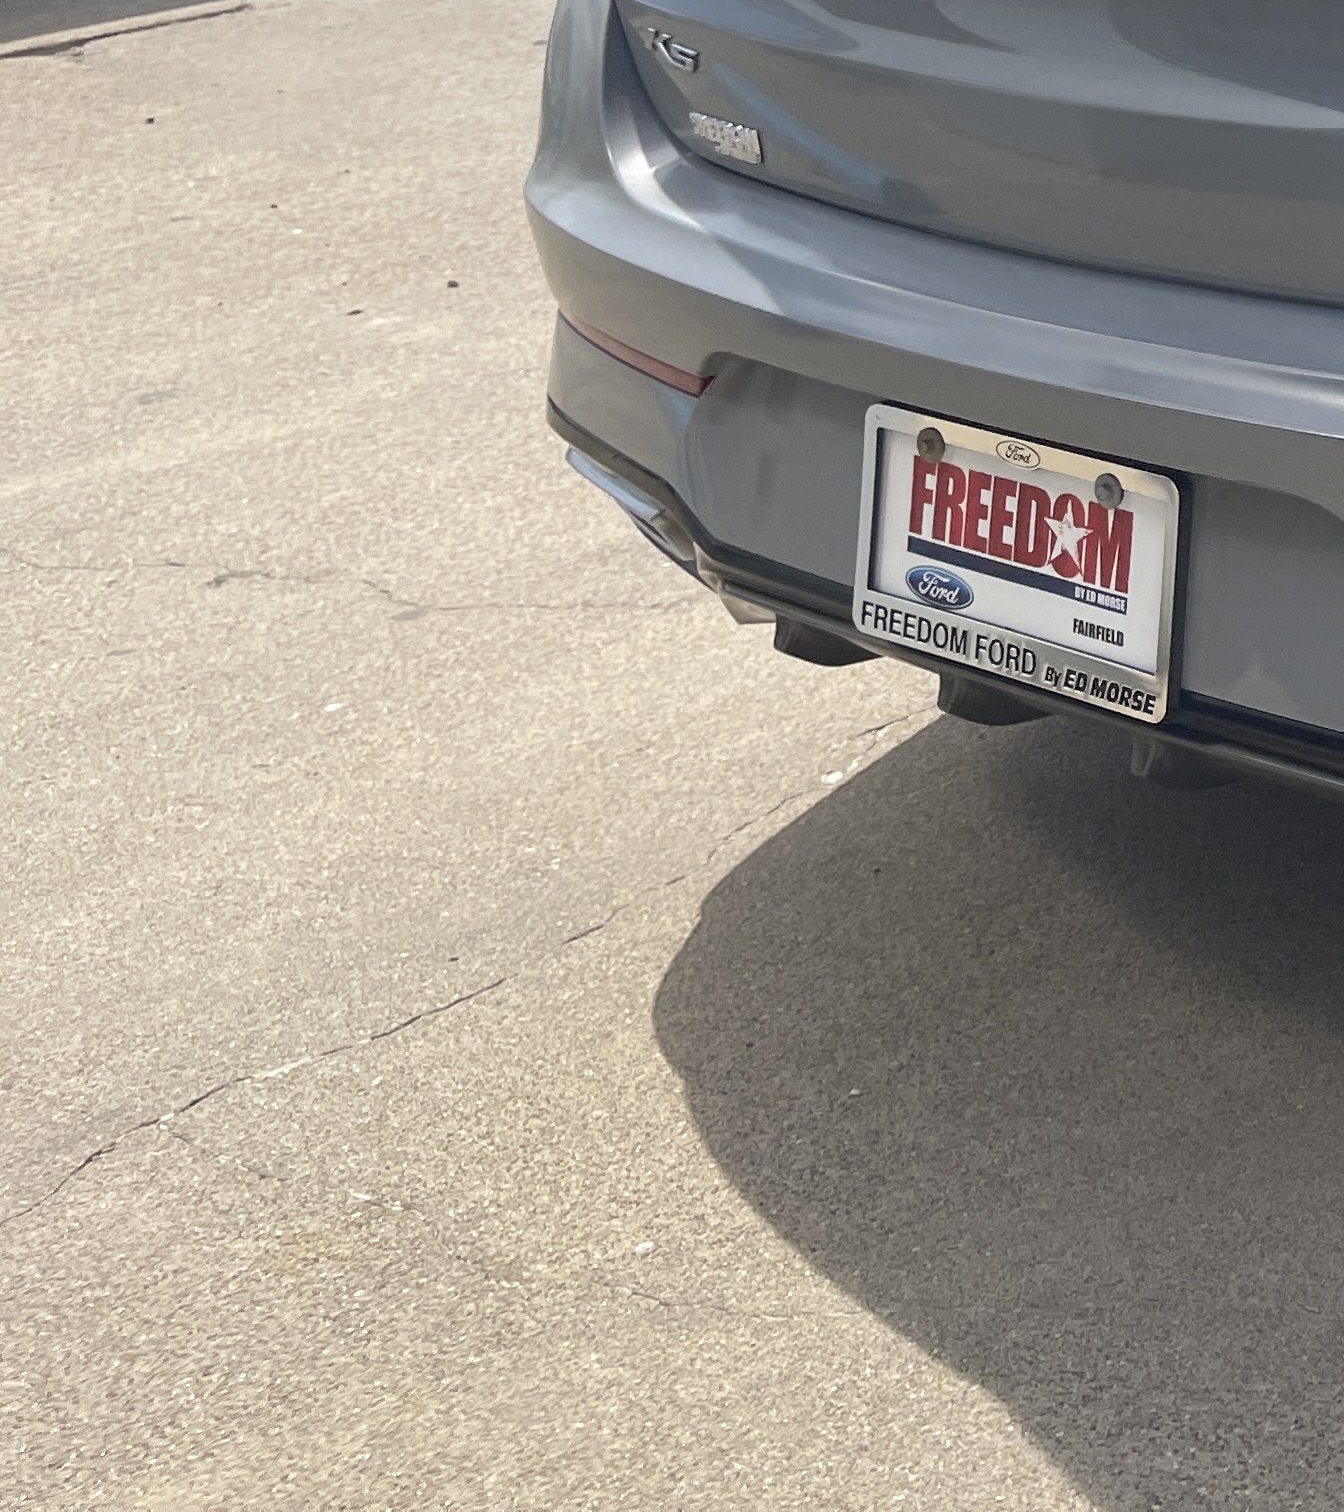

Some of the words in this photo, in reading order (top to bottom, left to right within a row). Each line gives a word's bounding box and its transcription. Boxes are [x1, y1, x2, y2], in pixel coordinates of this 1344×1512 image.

[643, 27, 700, 72] K5
[1005, 444, 1031, 464] Ford
[908, 455, 1134, 594] FREEDOM
[918, 571, 961, 605] Ford
[1074, 586, 1085, 599] BY
[1086, 589, 1096, 603] ED
[1097, 592, 1126, 611] MORSE
[1072, 618, 1124, 647] FAIRFIELD
[861, 601, 968, 657] FREEDOM
[974, 634, 1037, 676] FORD
[1044, 666, 1062, 687] By
[1063, 668, 1088, 693] ED
[1089, 677, 1157, 716] MORSE
